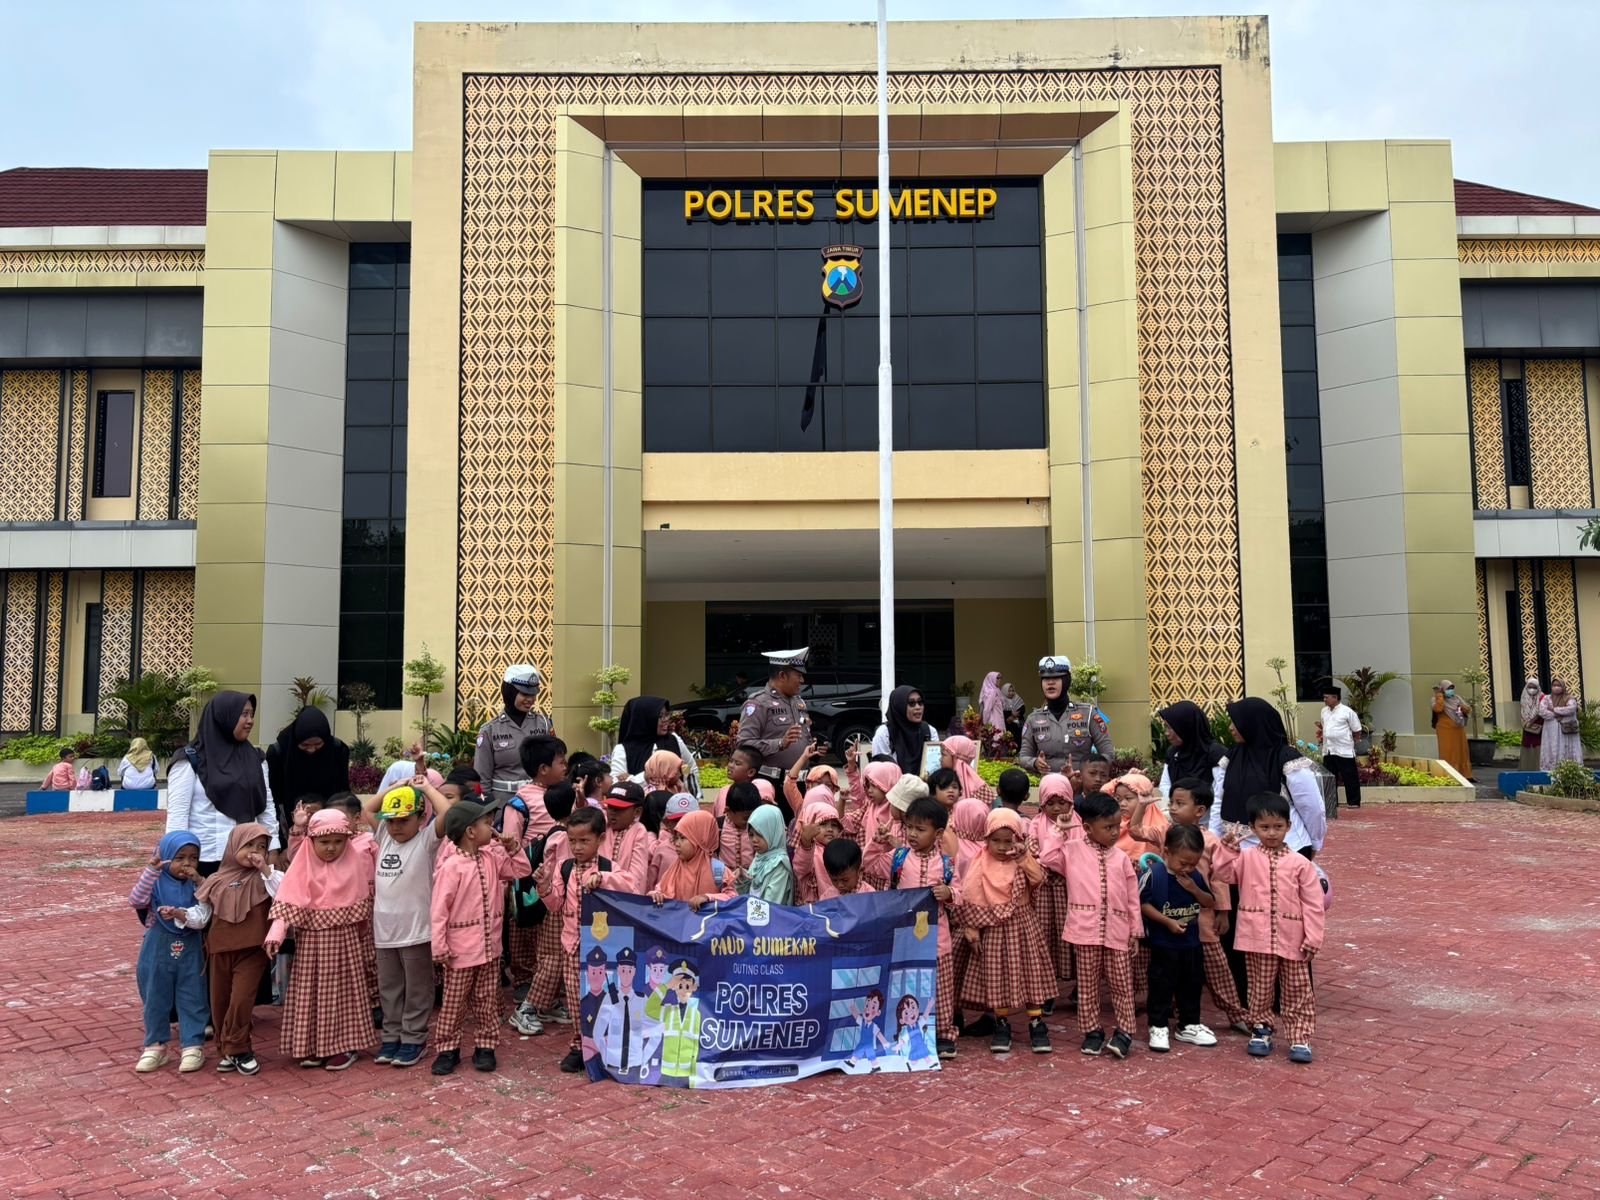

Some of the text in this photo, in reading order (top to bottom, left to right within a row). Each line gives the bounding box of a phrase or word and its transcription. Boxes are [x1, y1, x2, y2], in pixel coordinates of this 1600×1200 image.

[684, 187, 997, 219] POLRES SUMENEP
[711, 936, 817, 956] PAUD SUMEKAR
[733, 963, 784, 975] OUTING CLASS
[715, 981, 808, 1016] POLRES
[700, 1017, 820, 1051] SUMENEP
